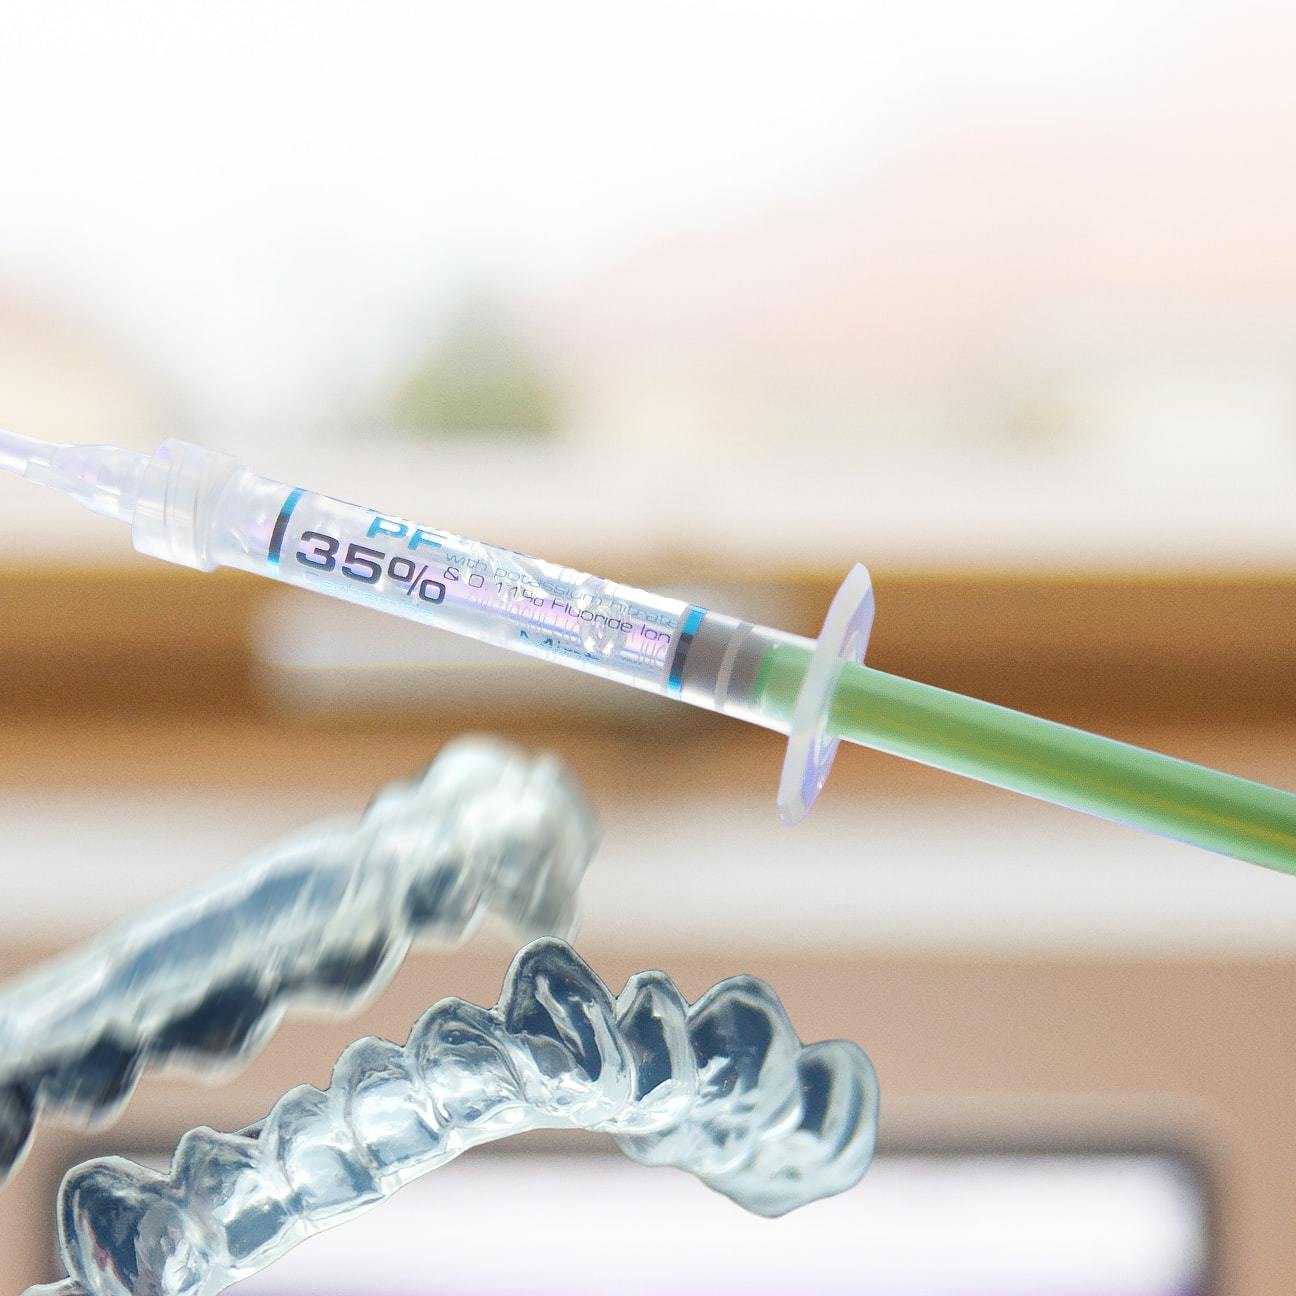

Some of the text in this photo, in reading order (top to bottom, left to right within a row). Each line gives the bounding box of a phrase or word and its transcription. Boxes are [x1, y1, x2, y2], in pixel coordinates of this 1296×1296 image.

[366, 516, 448, 550] PF
[295, 530, 446, 605] 35%
[445, 552, 488, 572] with
[443, 566, 460, 582] &
[551, 597, 634, 634] Fluoride
[640, 623, 672, 644] Ion
